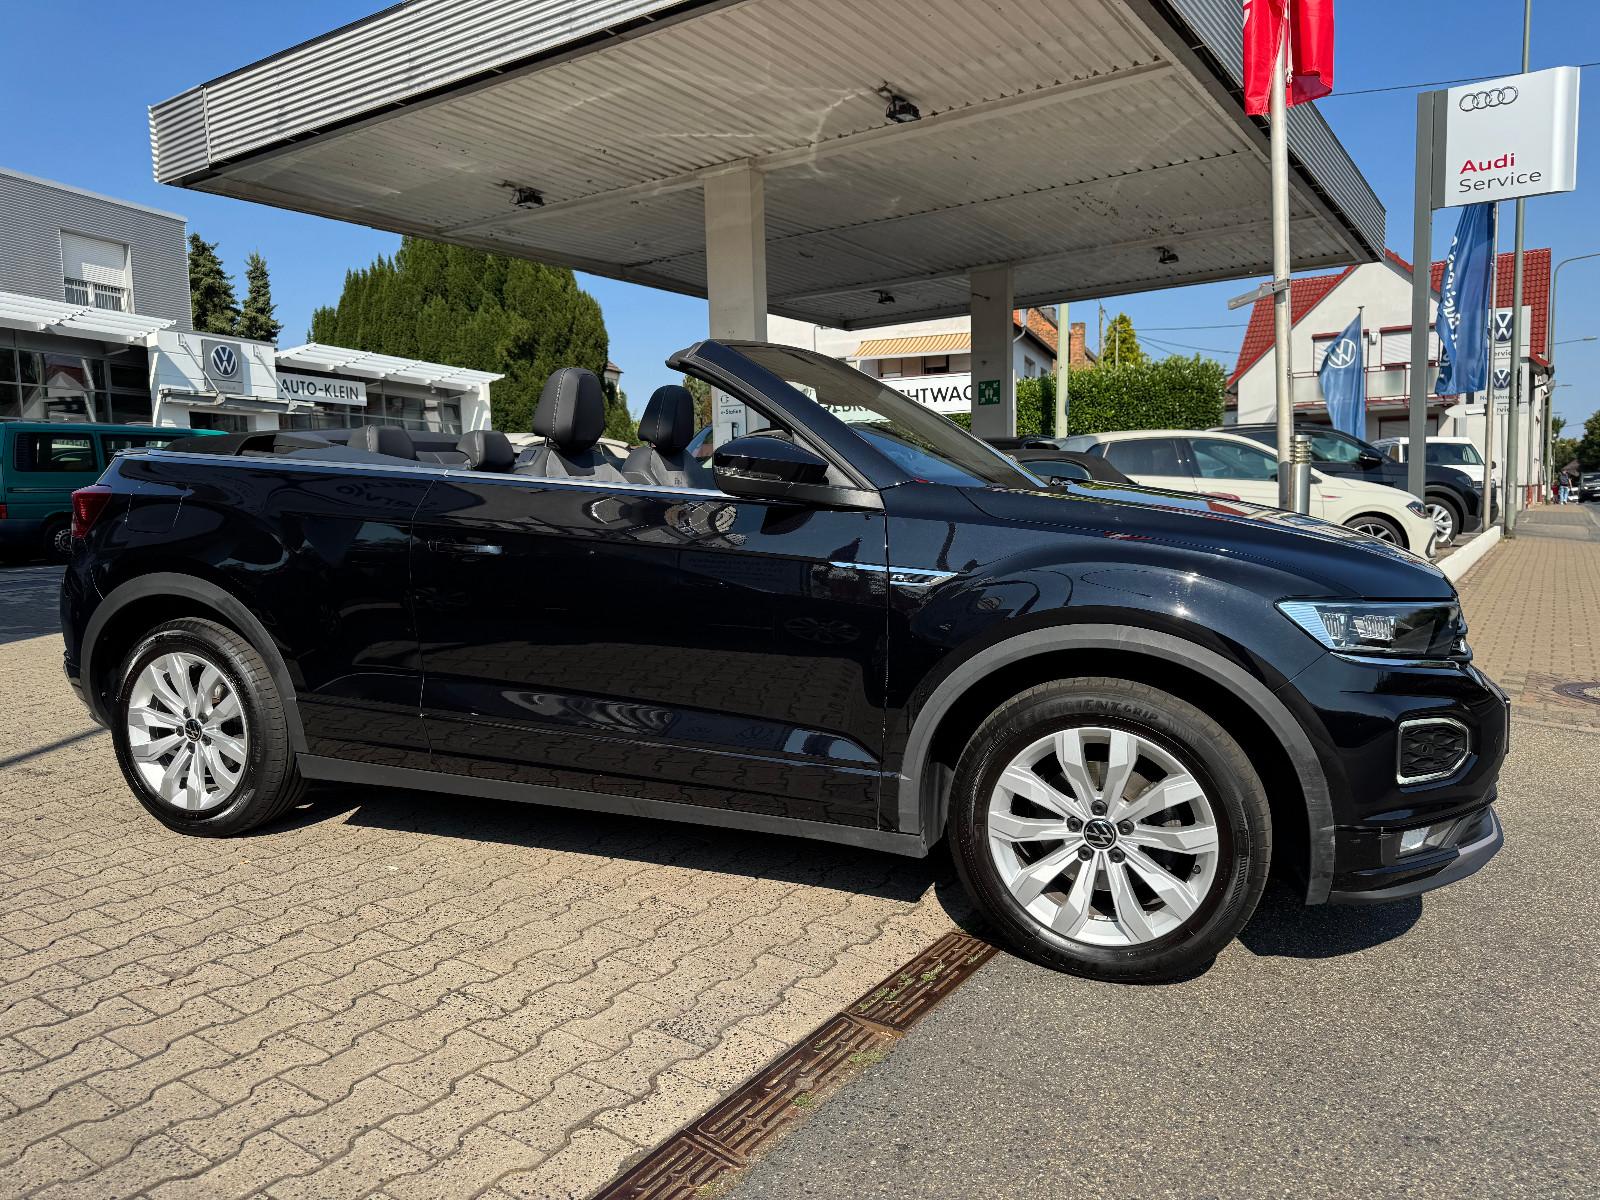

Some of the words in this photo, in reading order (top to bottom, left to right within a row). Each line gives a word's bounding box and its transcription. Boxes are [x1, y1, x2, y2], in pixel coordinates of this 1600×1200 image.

[1460, 152, 1515, 175] Audi
[1458, 171, 1542, 193] Service
[280, 377, 359, 400] AUTO-KLEIN
